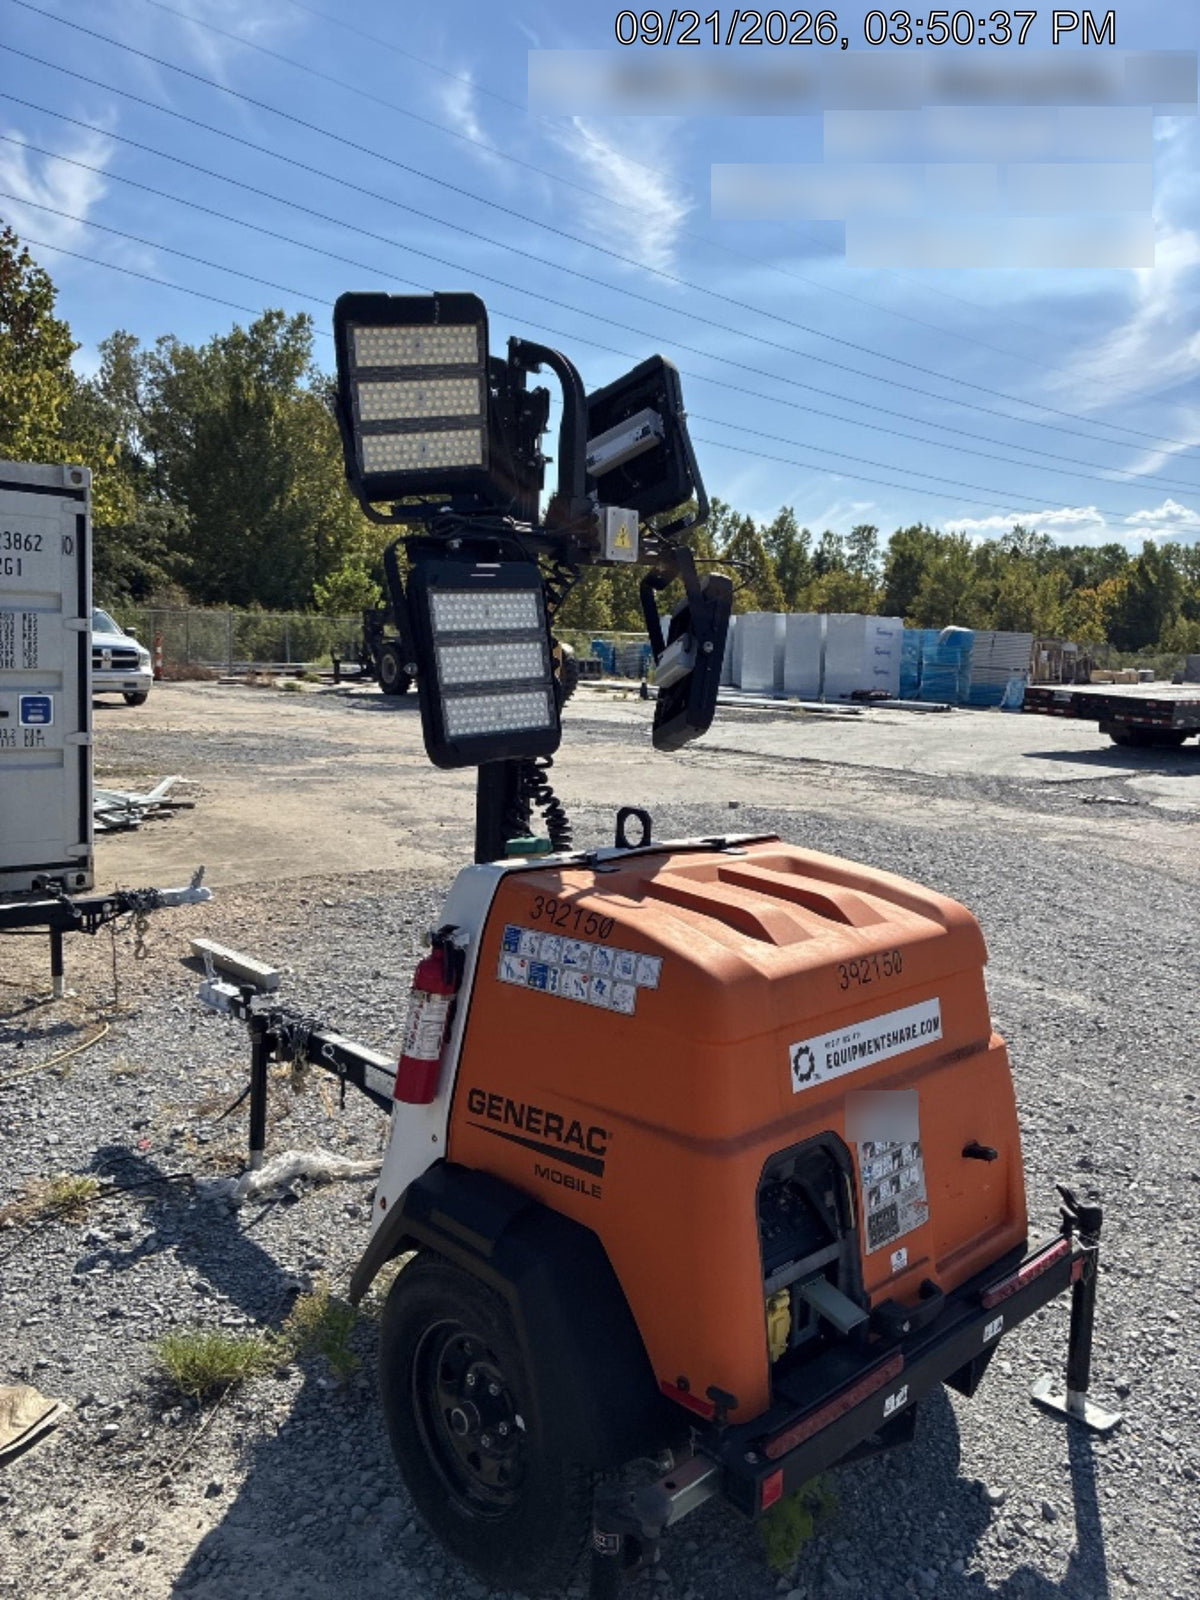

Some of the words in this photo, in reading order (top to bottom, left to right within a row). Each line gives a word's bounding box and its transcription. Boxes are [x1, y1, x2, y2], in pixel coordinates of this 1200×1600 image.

[529, 895, 617, 939] 392150
[838, 950, 903, 990] 392150
[825, 1015, 940, 1069] EQUIPMENTSHARE.COM
[467, 1087, 608, 1156] GENERAC
[534, 1163, 603, 1199] MOBILE
